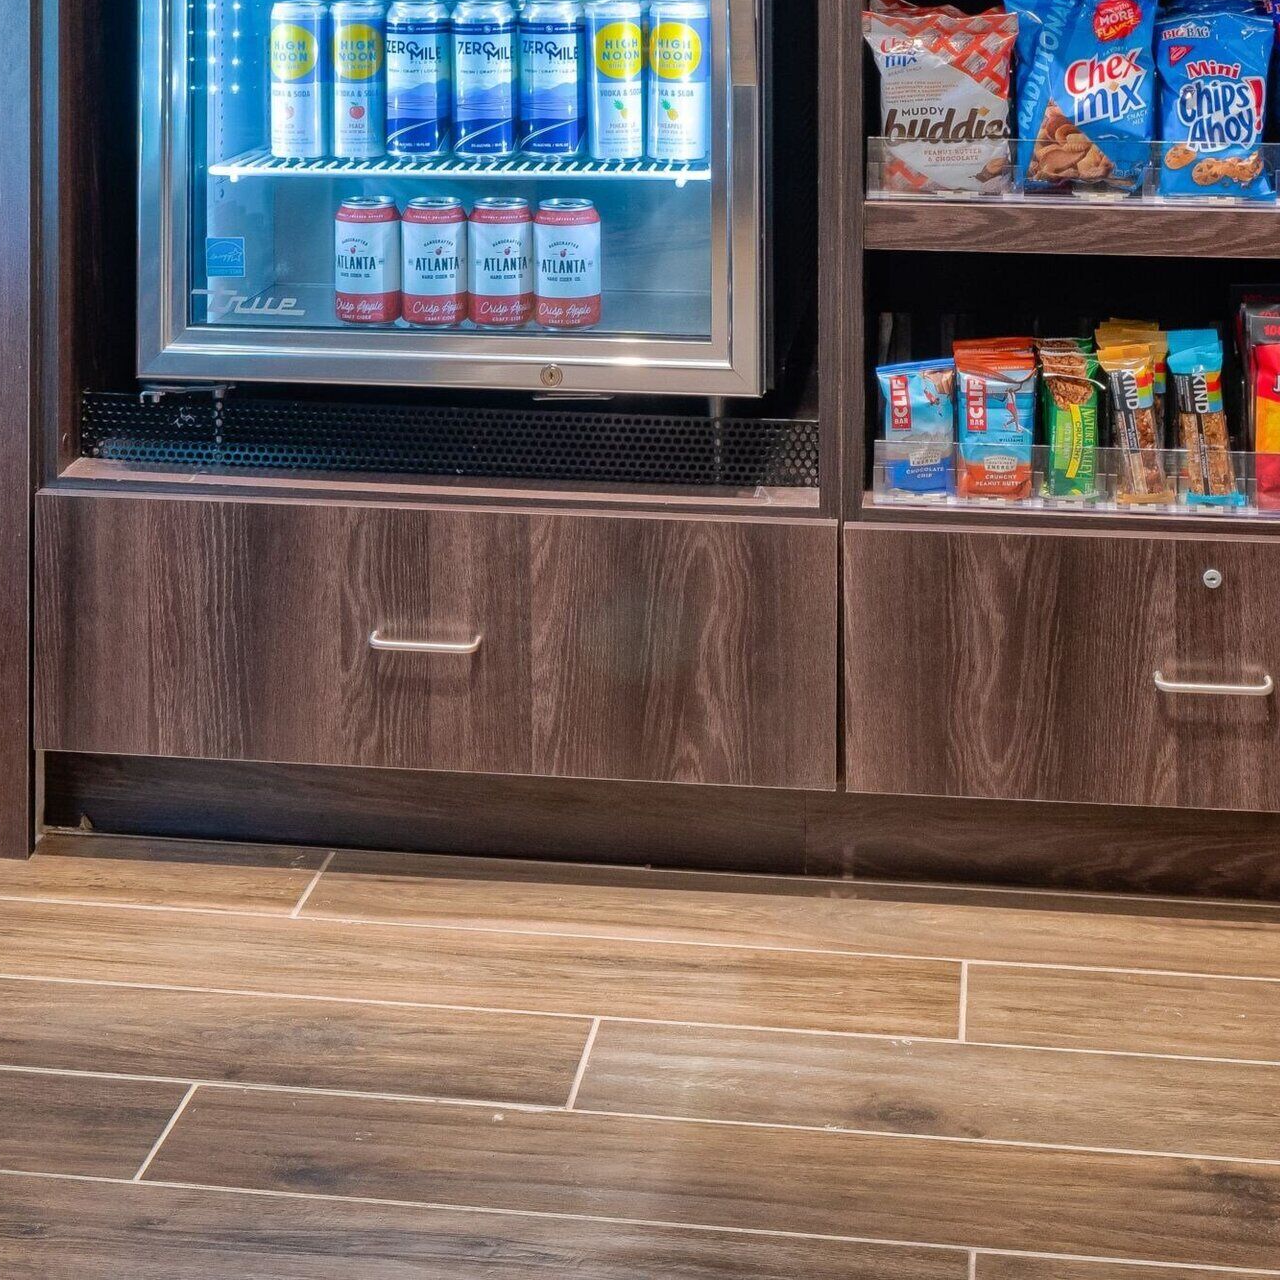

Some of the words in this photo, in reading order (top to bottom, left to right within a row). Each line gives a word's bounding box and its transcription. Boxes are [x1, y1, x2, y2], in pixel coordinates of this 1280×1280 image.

[1099, 9, 1135, 26] MORE
[1162, 27, 1186, 40] BIG
[1186, 25, 1210, 39] BAG
[386, 41, 420, 55] ZERO
[409, 47, 442, 63] MILE
[523, 40, 556, 55] ZERO
[549, 47, 579, 62] MILE
[605, 39, 639, 49] HIGH
[602, 52, 640, 61] NOON
[1065, 50, 1142, 96] Chex
[1186, 61, 1240, 80] Mini
[1076, 74, 1144, 124] mix
[1178, 80, 1250, 125] Chips
[901, 105, 945, 117] MUDDY
[337, 254, 377, 270] ATLANTA
[415, 256, 460, 272] ATLANTA
[483, 256, 528, 272] ATLANTA
[541, 258, 586, 274] ATLANTA
[891, 376, 909, 417] CLIF
[968, 377, 986, 419] CLIF
[1120, 369, 1140, 410] KIND
[1193, 369, 1210, 414] KIND
[893, 415, 910, 425] BAR
[968, 418, 985, 429] BAR
[1081, 406, 1096, 441] NATURE
[1073, 420, 1081, 462] CRUNCHY
